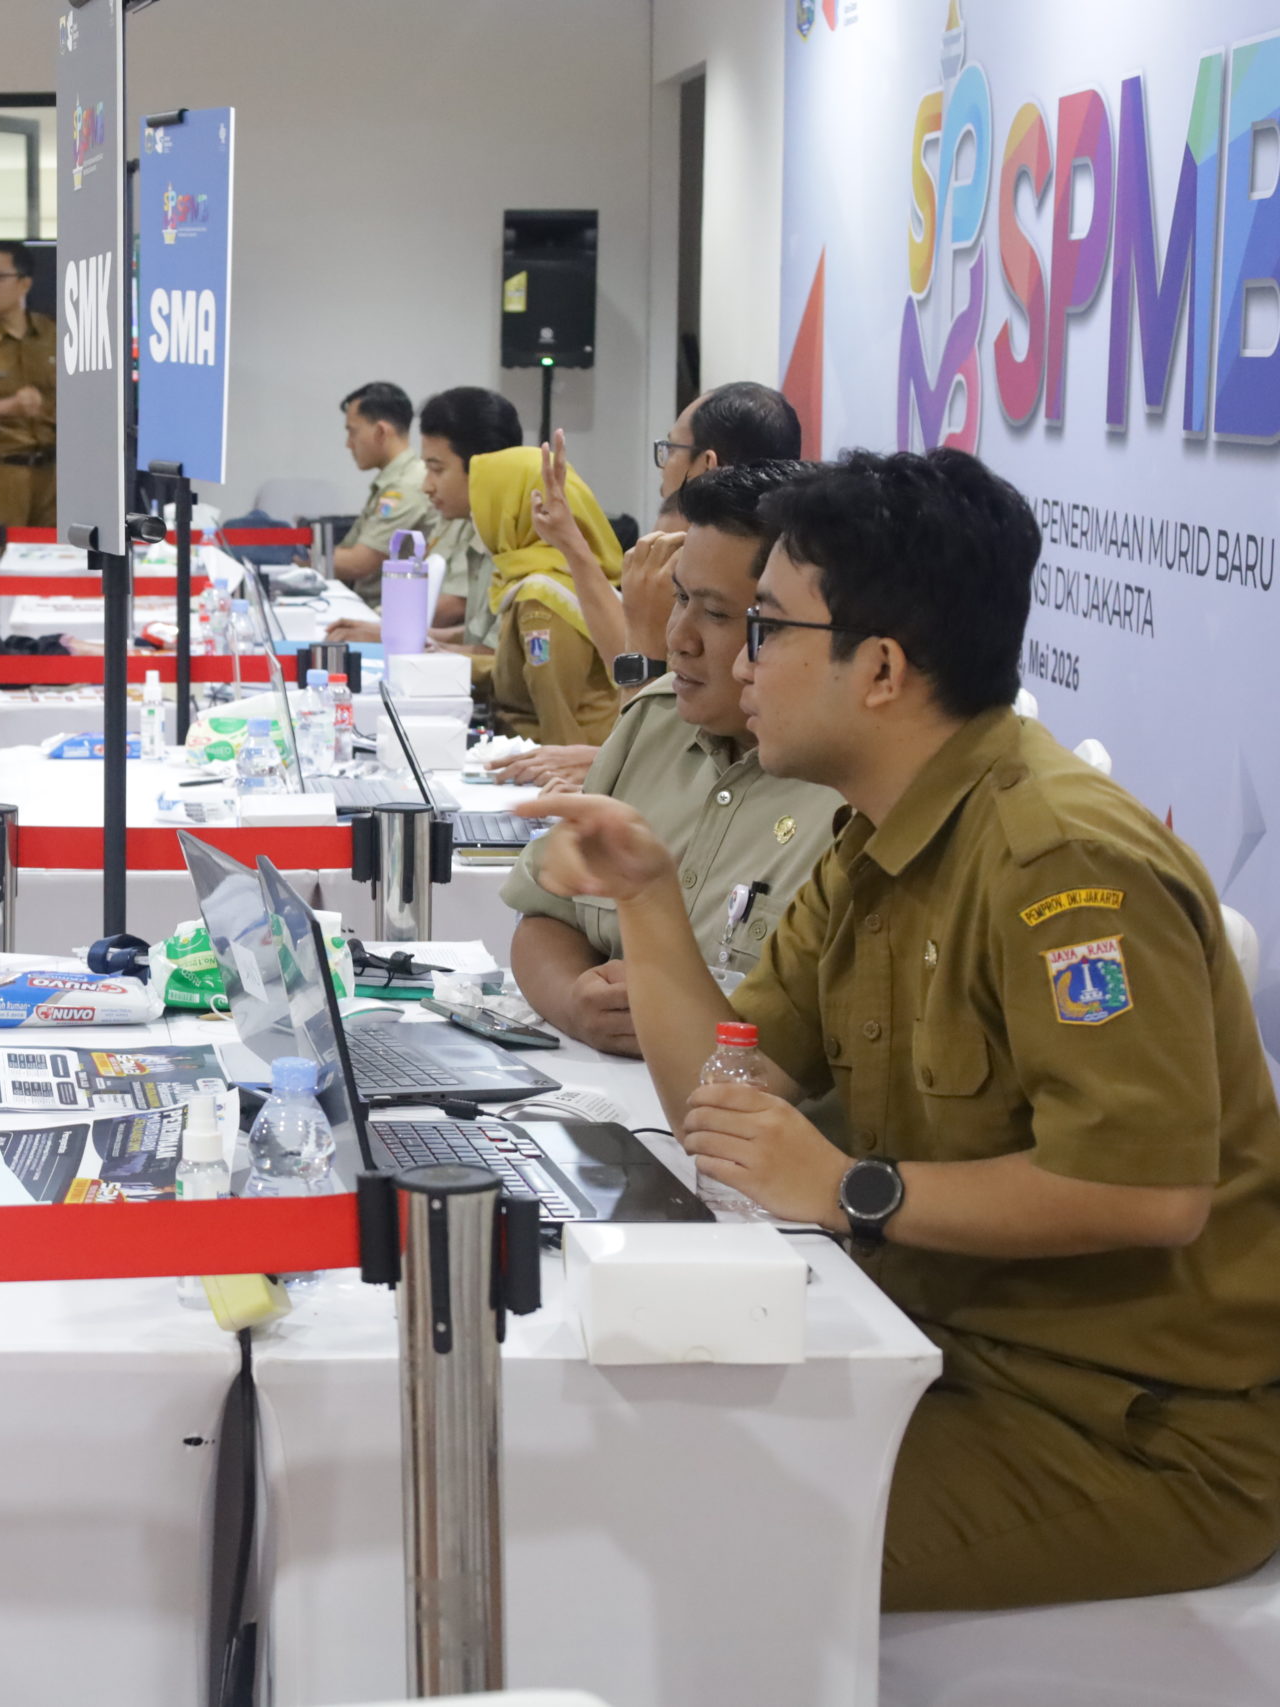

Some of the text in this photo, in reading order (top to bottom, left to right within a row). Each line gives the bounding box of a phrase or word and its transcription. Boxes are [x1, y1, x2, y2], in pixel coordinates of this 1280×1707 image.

[993, 28, 1280, 447] SPMB
[64, 251, 113, 375] SMK
[149, 288, 216, 366] SMA
[1041, 498, 1275, 592] PENERIMAAN MURID BARU
[1055, 566, 1080, 616] DKI
[1082, 573, 1154, 638] JAKARTA
[1028, 639, 1050, 680] Mei
[1051, 647, 1080, 691] 2026
[1067, 891, 1082, 905] DKI
[1084, 889, 1120, 906] JAKARTA
[1051, 941, 1117, 964] JAYA RAYA
[51, 1007, 95, 1020] NUVO
